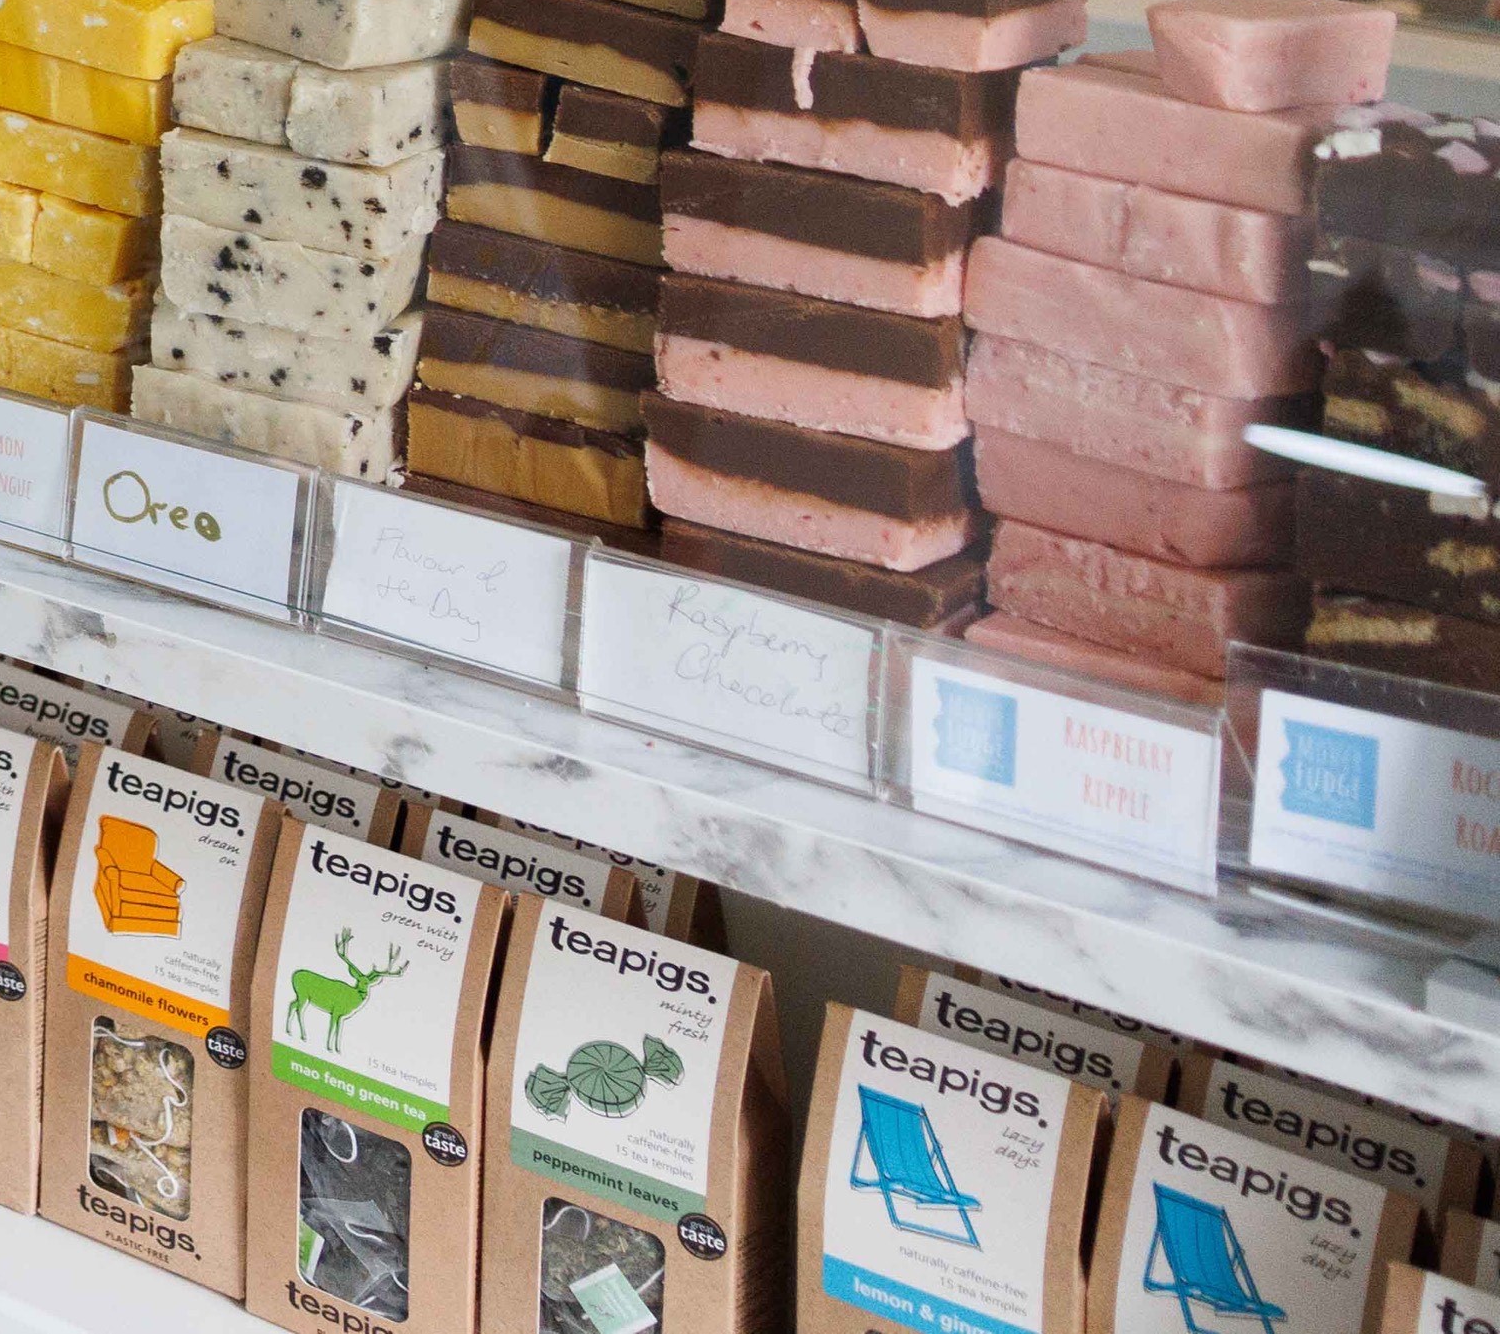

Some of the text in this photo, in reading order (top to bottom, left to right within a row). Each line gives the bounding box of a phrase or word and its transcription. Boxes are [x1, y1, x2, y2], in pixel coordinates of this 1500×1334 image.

[103, 469, 222, 542] Oreo
[373, 526, 467, 581] Flavour
[430, 587, 482, 643] Day
[674, 642, 850, 736] Chocolate
[1062, 715, 1174, 778] RASPBERRY
[106, 761, 245, 838] teapigs.
[222, 749, 362, 828] teapigs.
[1082, 772, 1152, 824] RIPPLE
[197, 833, 241, 855] dream
[219, 855, 238, 868] on
[436, 823, 592, 908] teapigs.
[309, 840, 463, 924] teapigs.
[381, 909, 459, 944] green with
[416, 940, 455, 962] envy
[549, 915, 718, 1006] teapigs.
[83, 970, 210, 1028] chamomile flowers
[658, 998, 715, 1028] minty
[207, 1038, 245, 1060] taste
[667, 1019, 710, 1044] fresh
[935, 990, 1122, 1090] teapigs.
[290, 1061, 427, 1122] mao feng green tea
[367, 1055, 439, 1093] 15 tea temples
[859, 1029, 1049, 1130] teapigs.
[423, 1134, 468, 1158] taste
[648, 1128, 697, 1154] naturally
[994, 1144, 1041, 1171] days
[1220, 1080, 1426, 1189] teapigs.
[531, 1145, 680, 1214] peppermint leaves
[614, 1144, 695, 1183] 15 tea temples
[1155, 1125, 1363, 1240] teapigs.
[76, 1183, 202, 1262] teapigs.
[104, 1229, 170, 1265] PLASTIC-FREE
[680, 1226, 726, 1253] taste
[689, 1218, 714, 1235] great
[899, 1244, 950, 1274] naturally
[285, 1280, 394, 1334] teapi
[853, 1276, 914, 1314] lemon
[918, 1303, 935, 1323] &
[957, 1284, 977, 1299] tea
